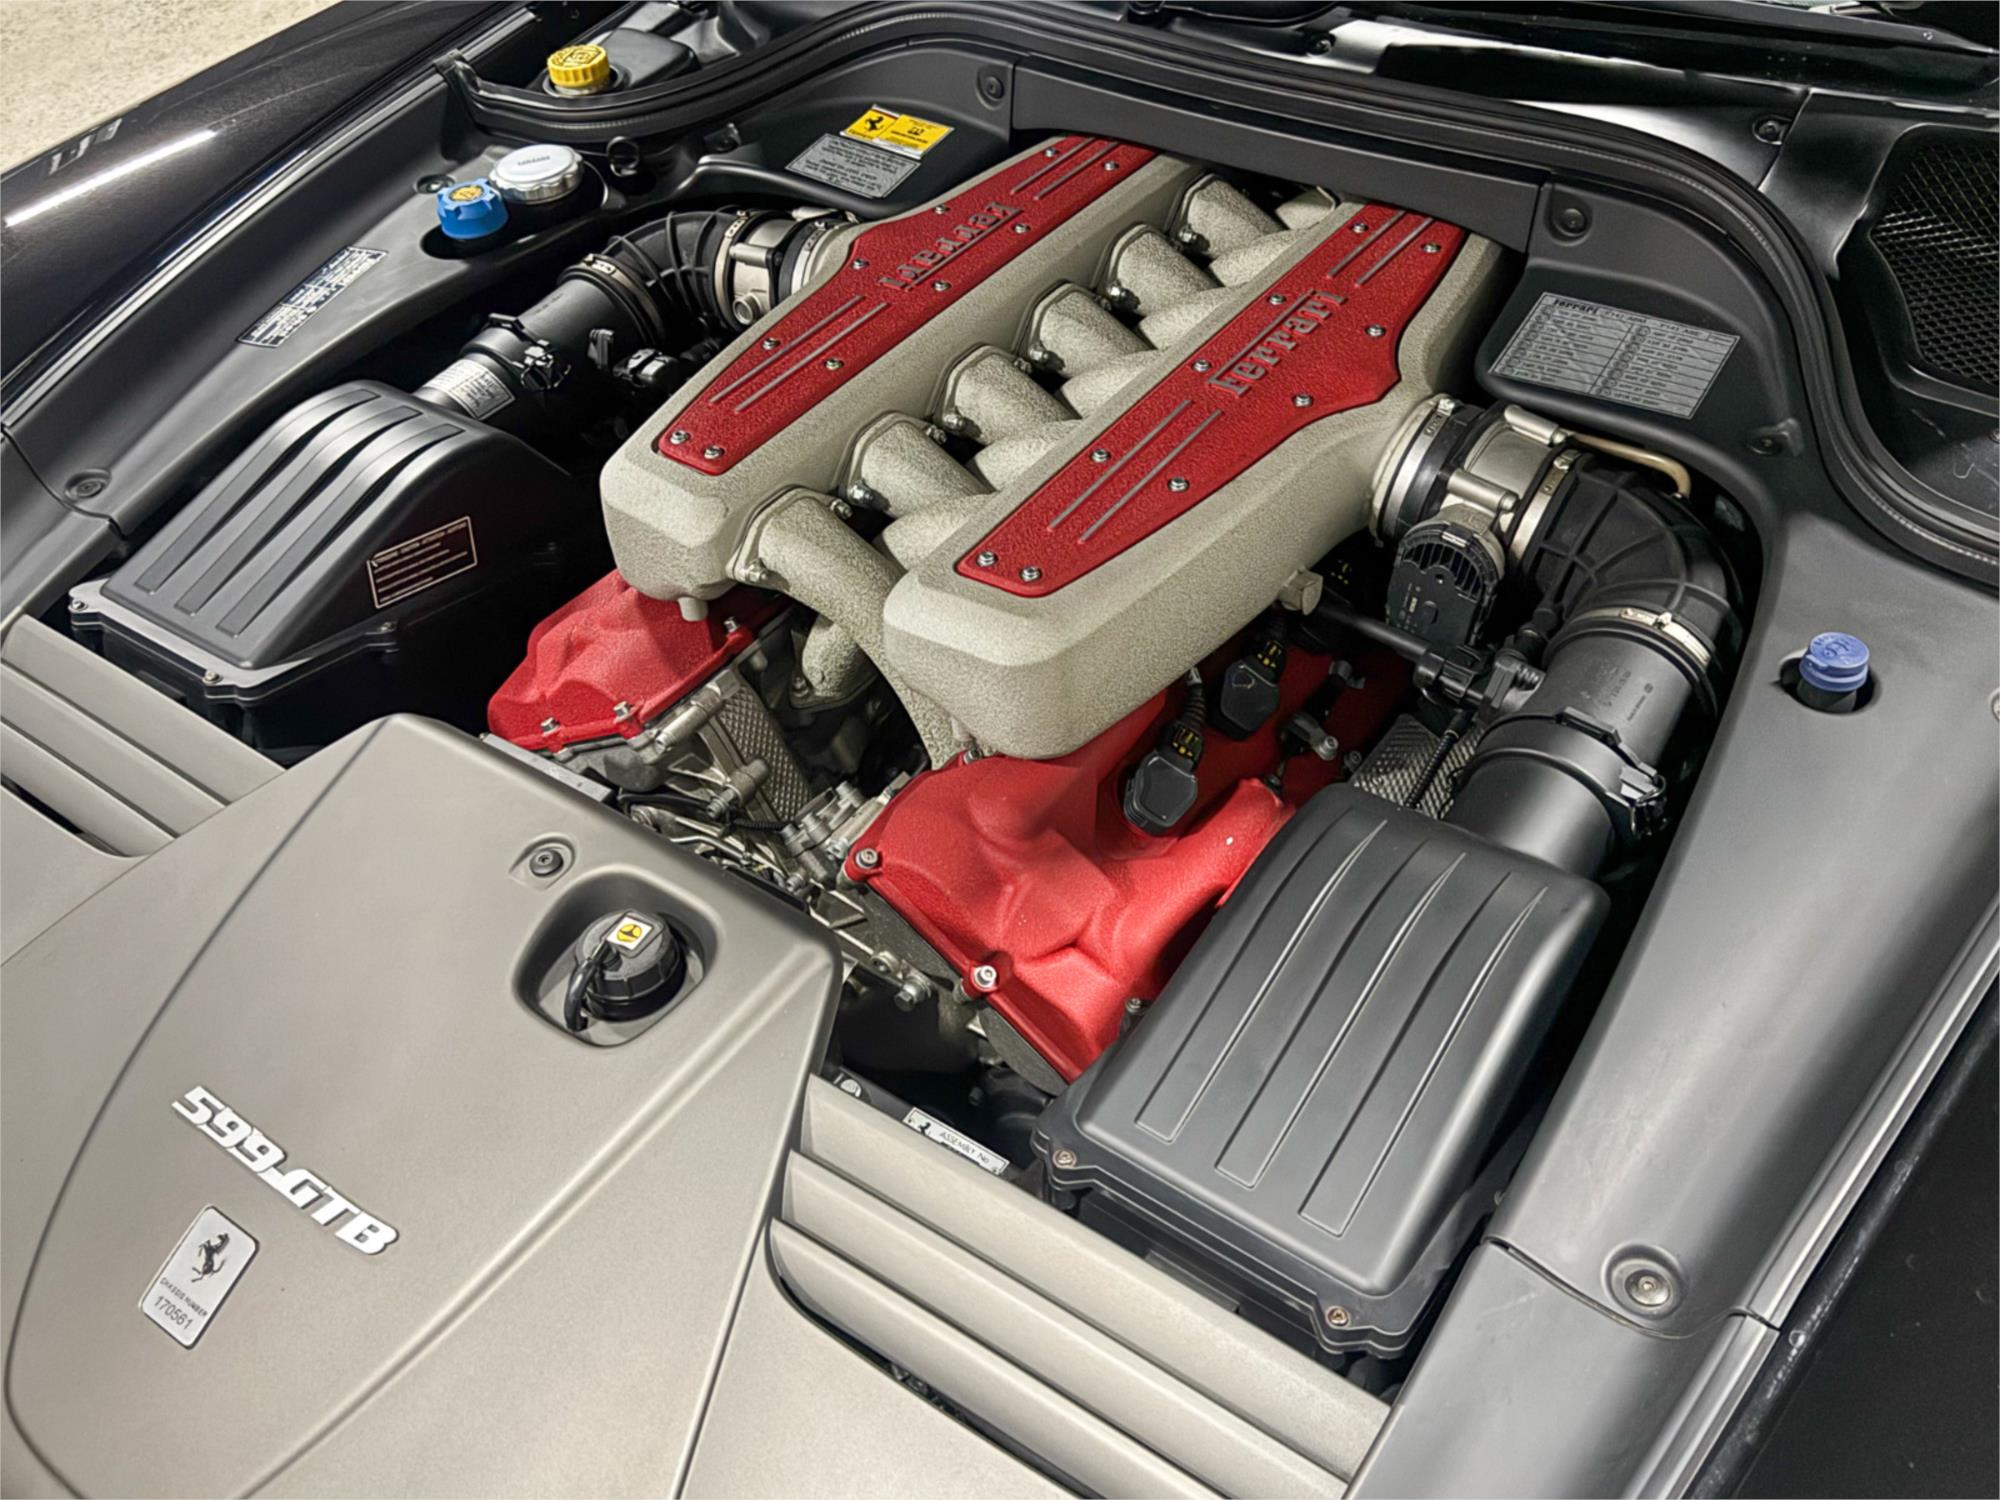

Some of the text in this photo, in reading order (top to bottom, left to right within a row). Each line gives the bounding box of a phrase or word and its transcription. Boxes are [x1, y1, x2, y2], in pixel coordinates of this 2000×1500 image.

[878, 202, 1022, 290] Ferrari
[1208, 289, 1347, 396] Ferrari
[171, 1086, 399, 1255] 599 GTB
[938, 1131, 977, 1155] ASSEMBLY
[153, 1295, 194, 1330] 170561
[159, 1276, 209, 1317] CHASSIS NUMBER
